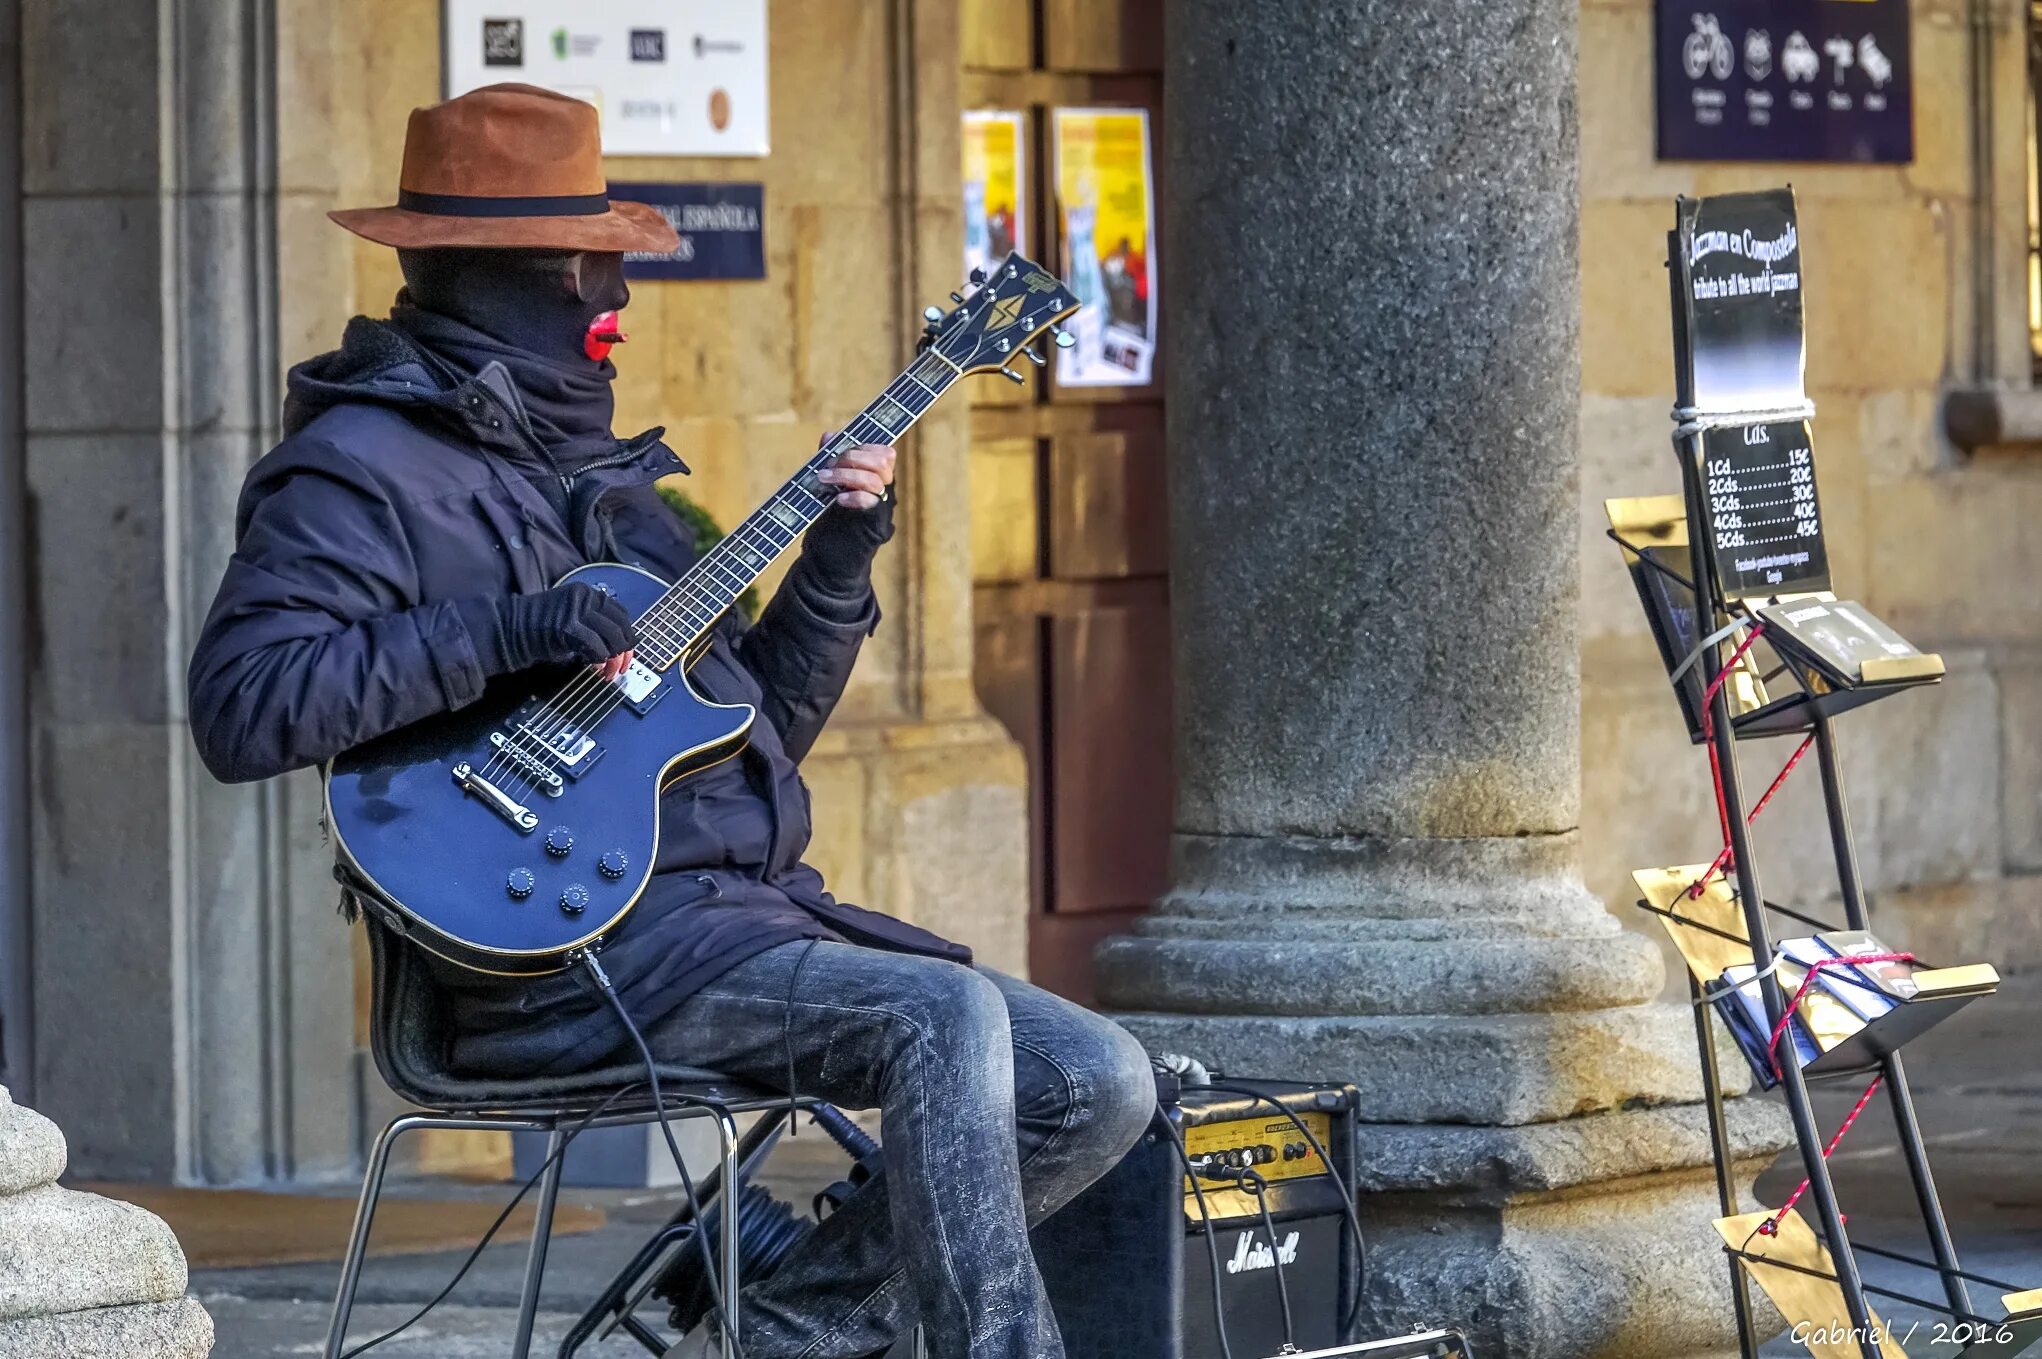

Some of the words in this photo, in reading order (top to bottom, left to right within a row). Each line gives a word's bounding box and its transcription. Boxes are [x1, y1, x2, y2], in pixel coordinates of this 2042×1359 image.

[683, 201, 760, 232] ESPAÑOLA
[1730, 233, 1743, 256] en
[1738, 272, 1750, 295] the
[1226, 1230, 1300, 1274] Marsall
